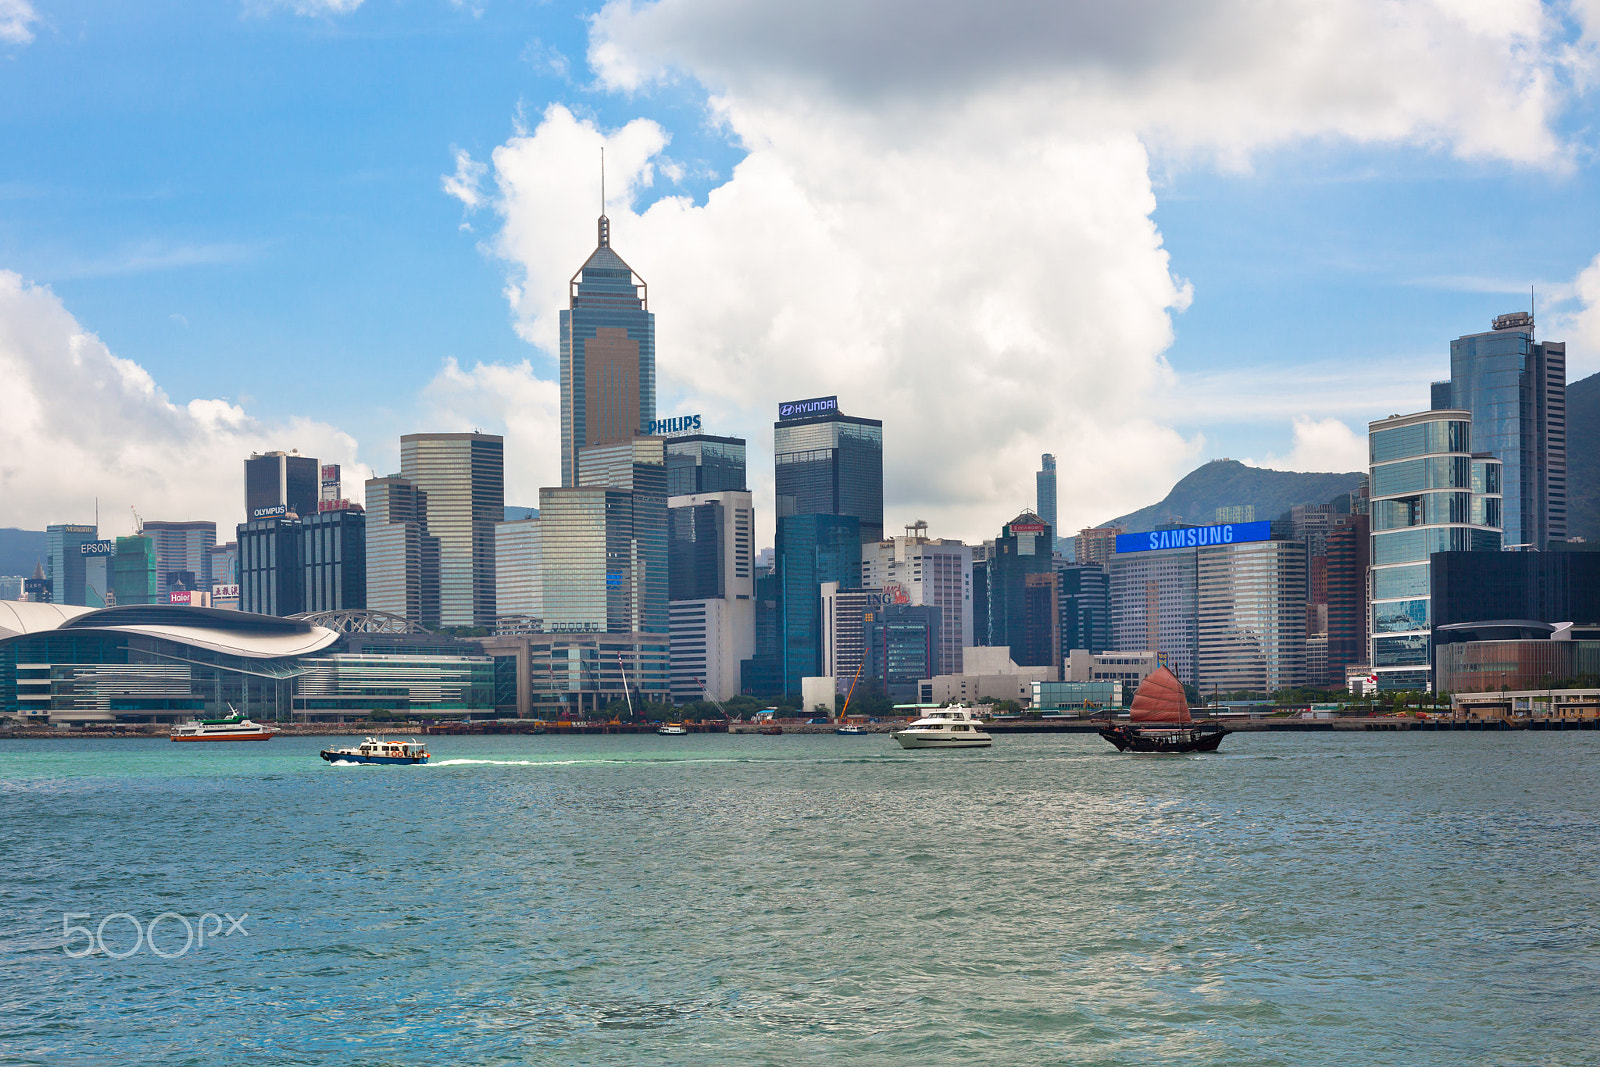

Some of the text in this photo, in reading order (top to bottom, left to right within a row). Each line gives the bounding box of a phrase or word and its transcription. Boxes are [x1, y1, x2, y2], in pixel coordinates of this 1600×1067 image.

[795, 399, 836, 414] HYUNDAI
[648, 414, 701, 435] PHILIPS
[254, 506, 285, 517] OLYMPUS
[1149, 525, 1233, 550] SAMSUNG
[81, 543, 110, 554] EPSON
[171, 593, 190, 602] Haier
[866, 593, 892, 605] ING
